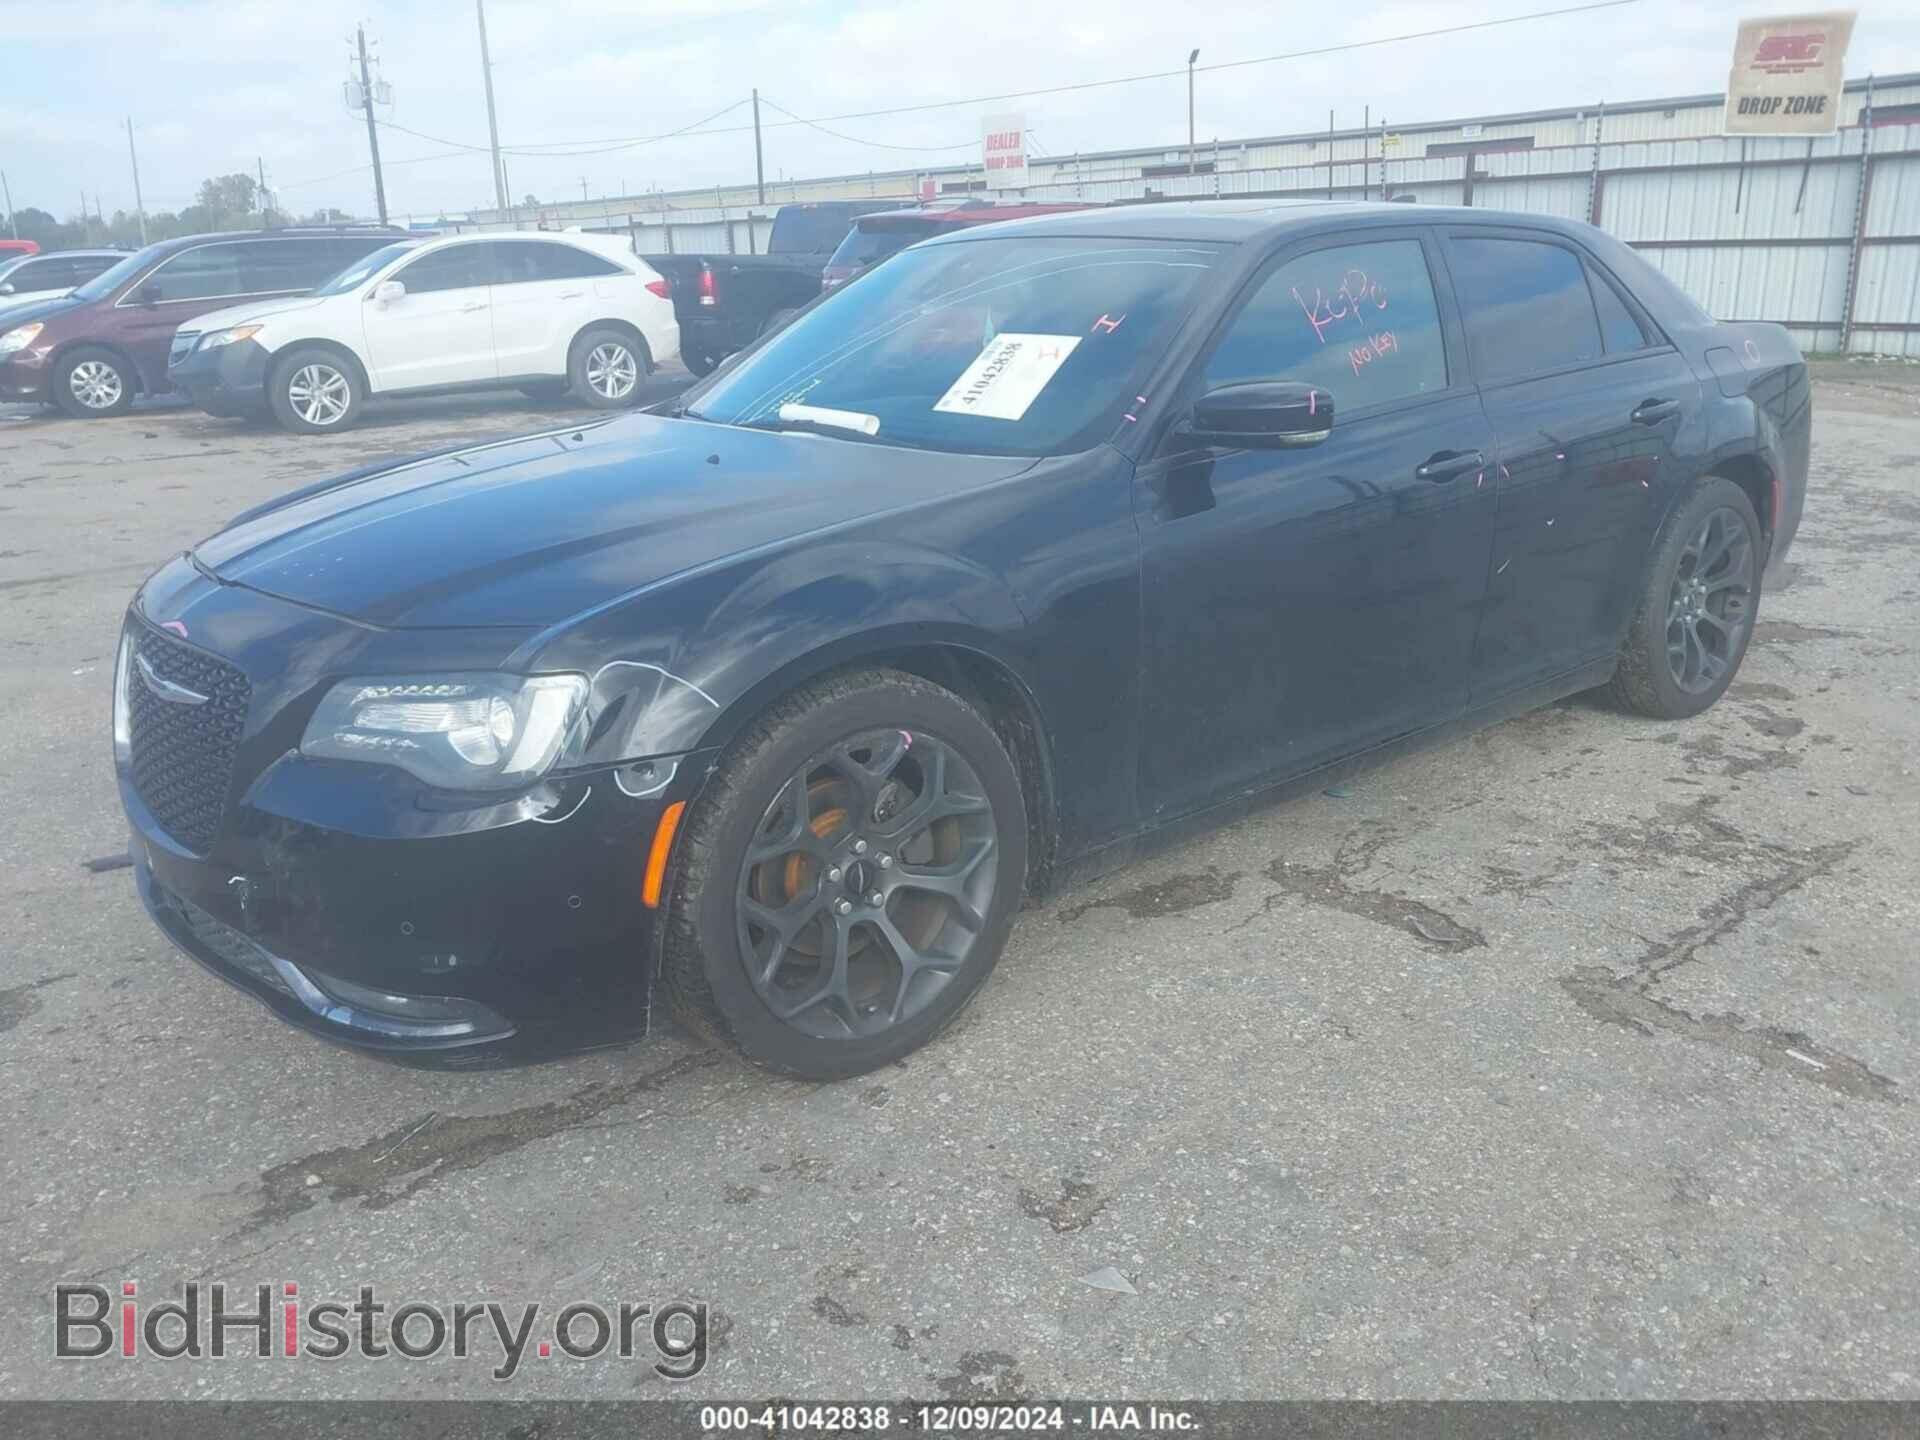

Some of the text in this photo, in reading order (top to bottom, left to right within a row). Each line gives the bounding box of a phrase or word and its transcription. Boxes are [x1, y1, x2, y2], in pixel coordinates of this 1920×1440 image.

[1737, 95, 1828, 115] DROP ZONE
[986, 131, 1021, 151] DEALER
[986, 154, 1024, 170] DROP ZONE
[962, 341, 1023, 406] 41042838
